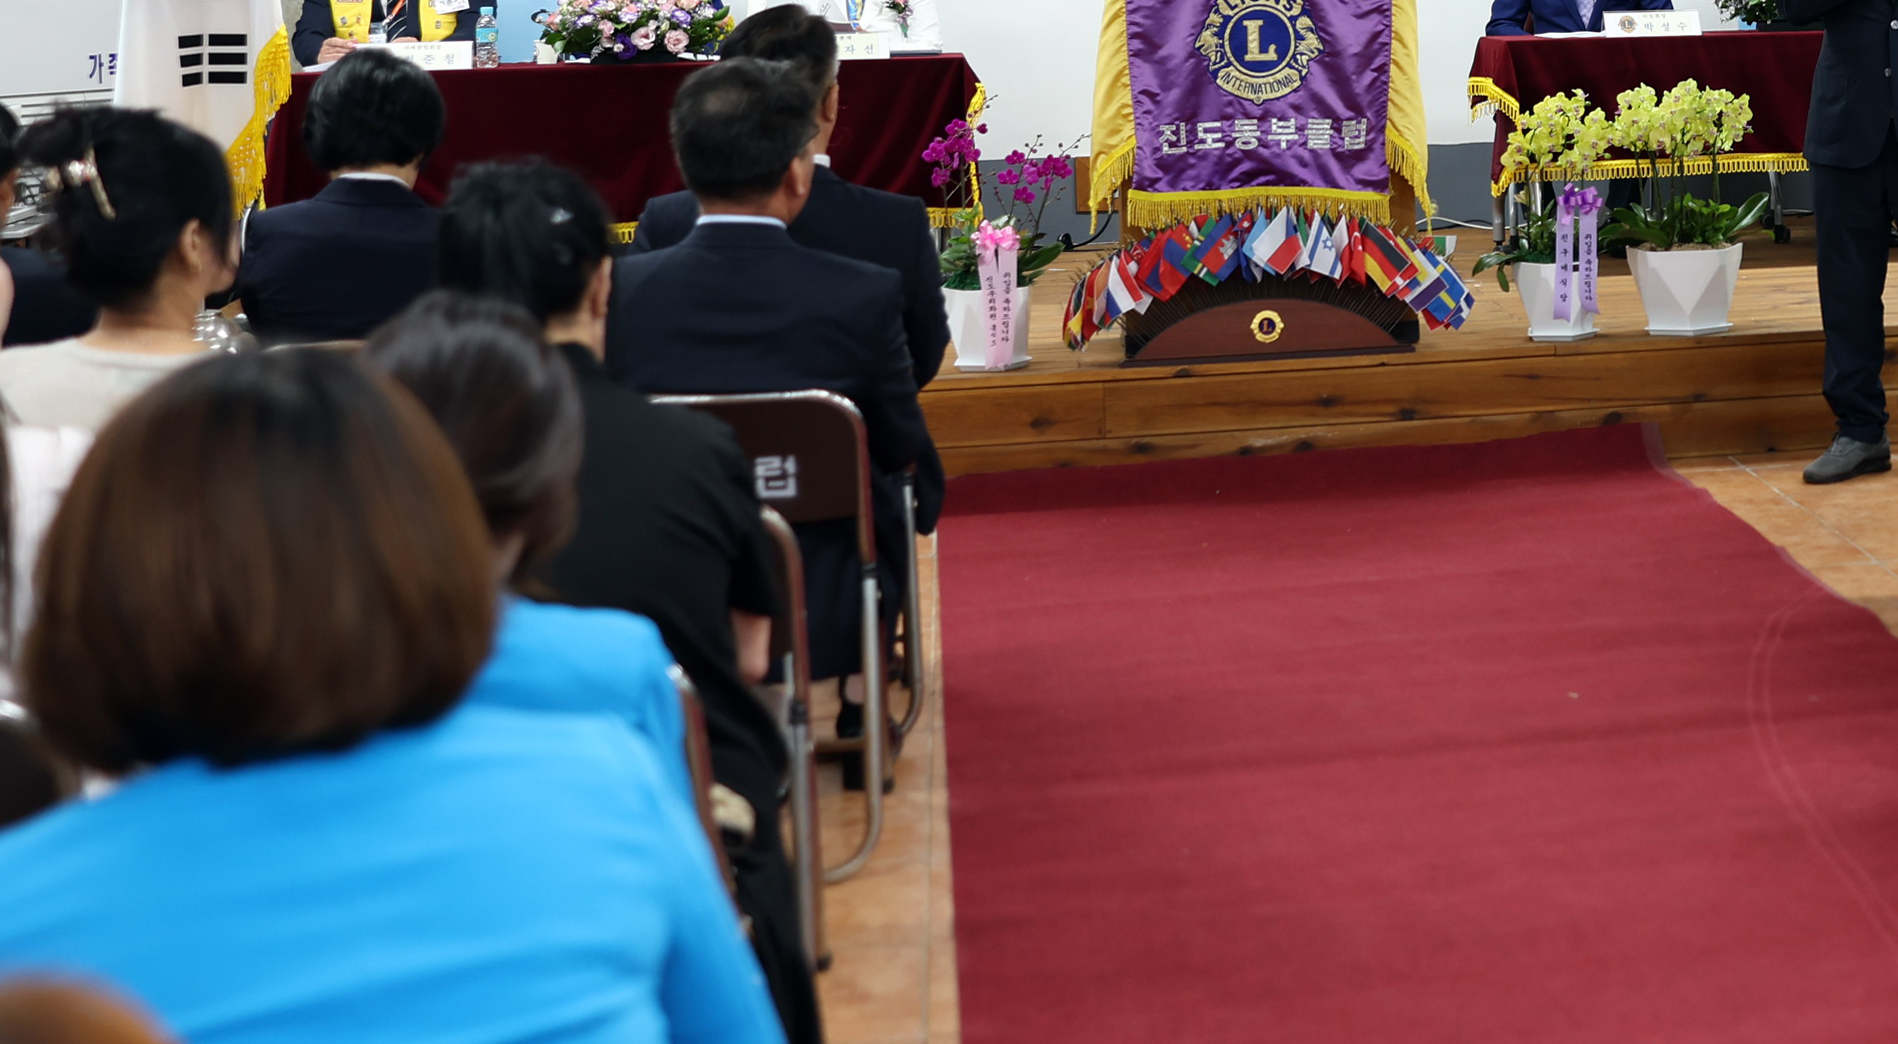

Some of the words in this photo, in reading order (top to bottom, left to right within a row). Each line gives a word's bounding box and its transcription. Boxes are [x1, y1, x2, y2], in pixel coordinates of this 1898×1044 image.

[1242, 19, 1278, 62] L
[1219, 71, 1299, 97] INTERNATIONAL
[1158, 117, 1368, 155] 진도동부클럽
